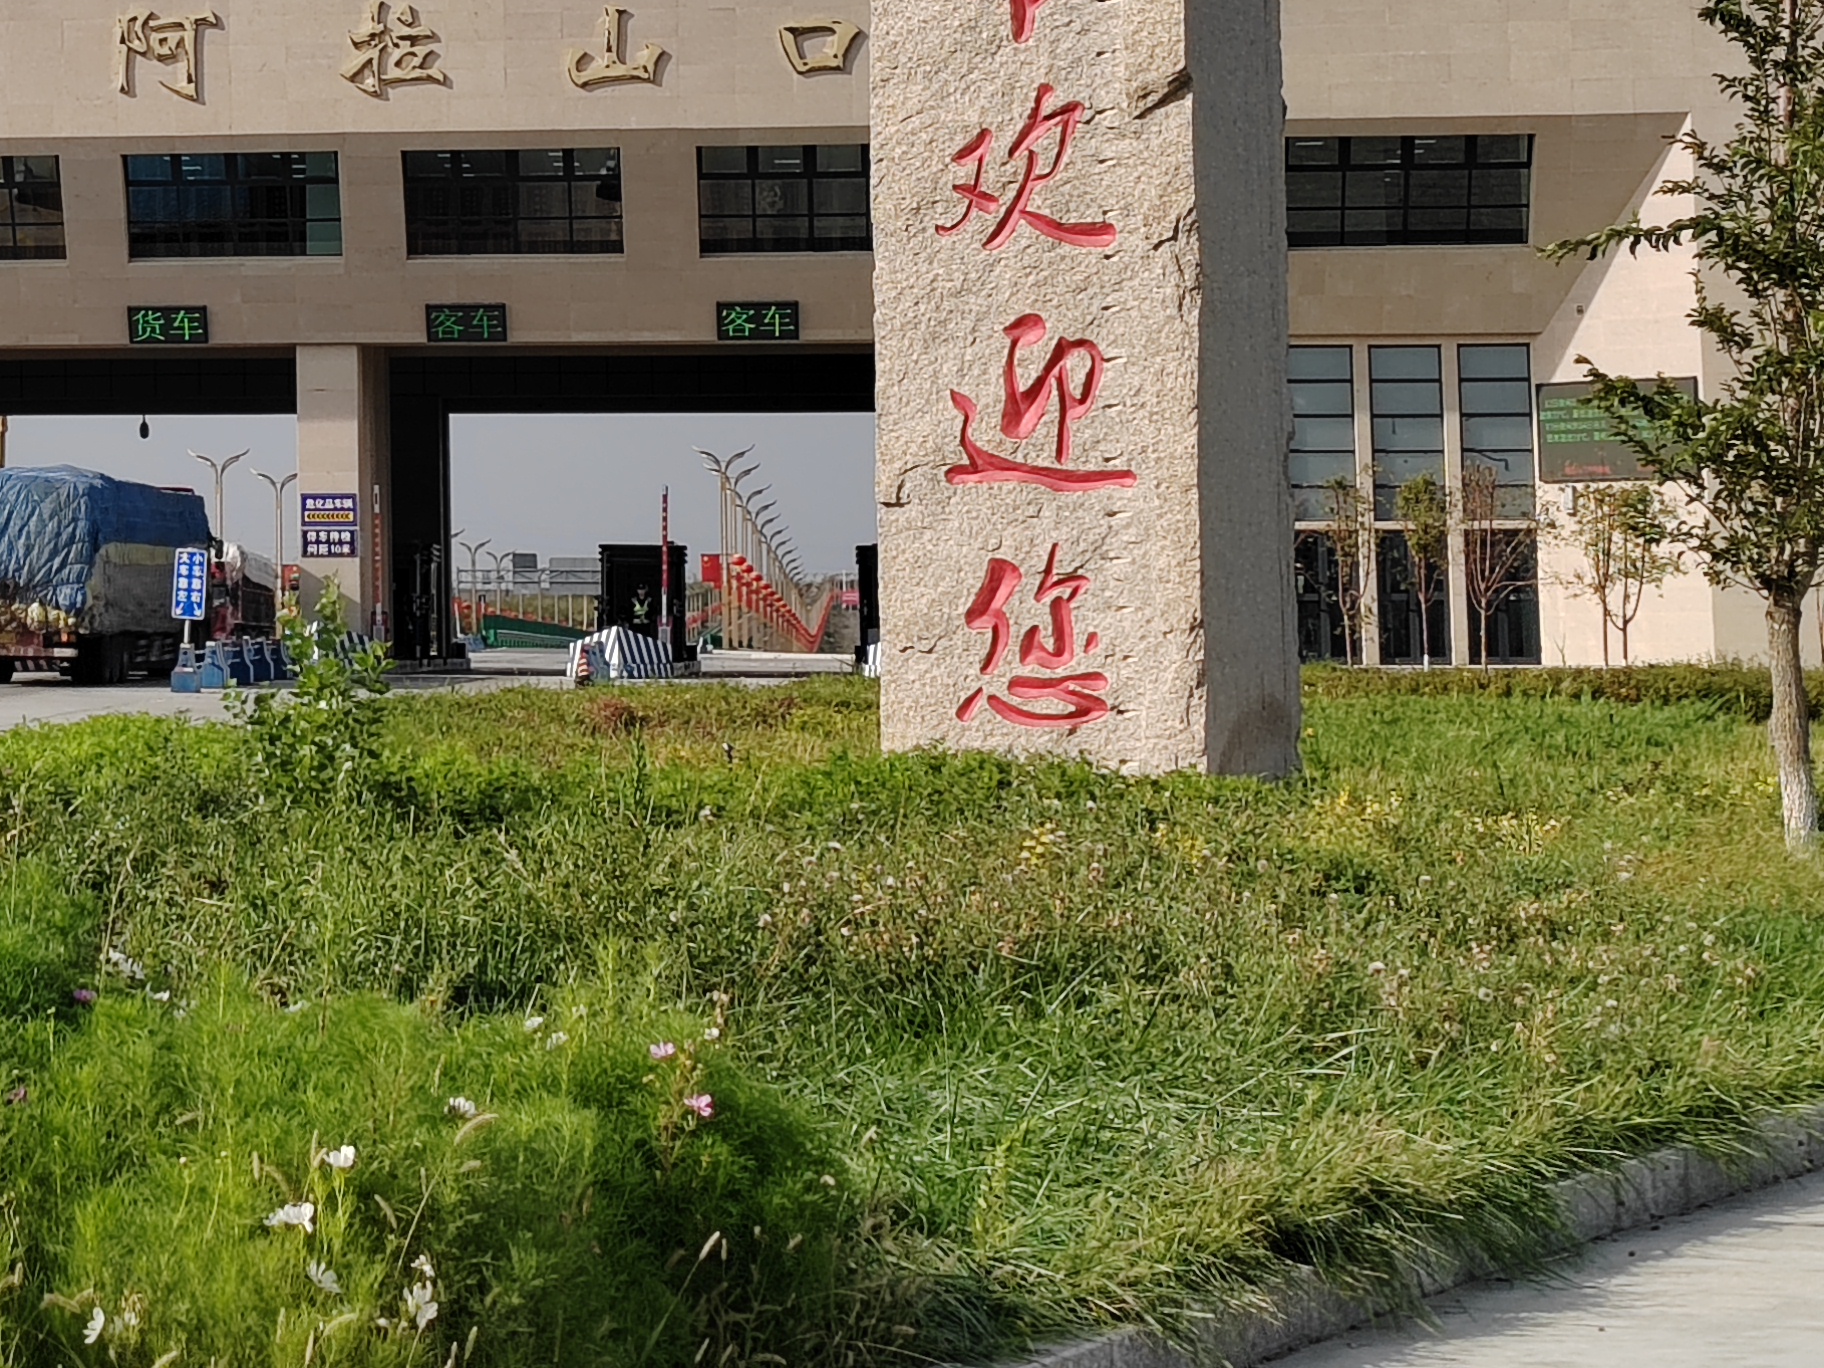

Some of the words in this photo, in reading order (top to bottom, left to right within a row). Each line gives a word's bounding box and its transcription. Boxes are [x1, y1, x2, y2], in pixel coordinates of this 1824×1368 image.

[118, 0, 866, 103] 阿拉山口
[130, 308, 204, 342] 货车
[429, 307, 504, 340] 客车
[720, 306, 796, 339] 客车
